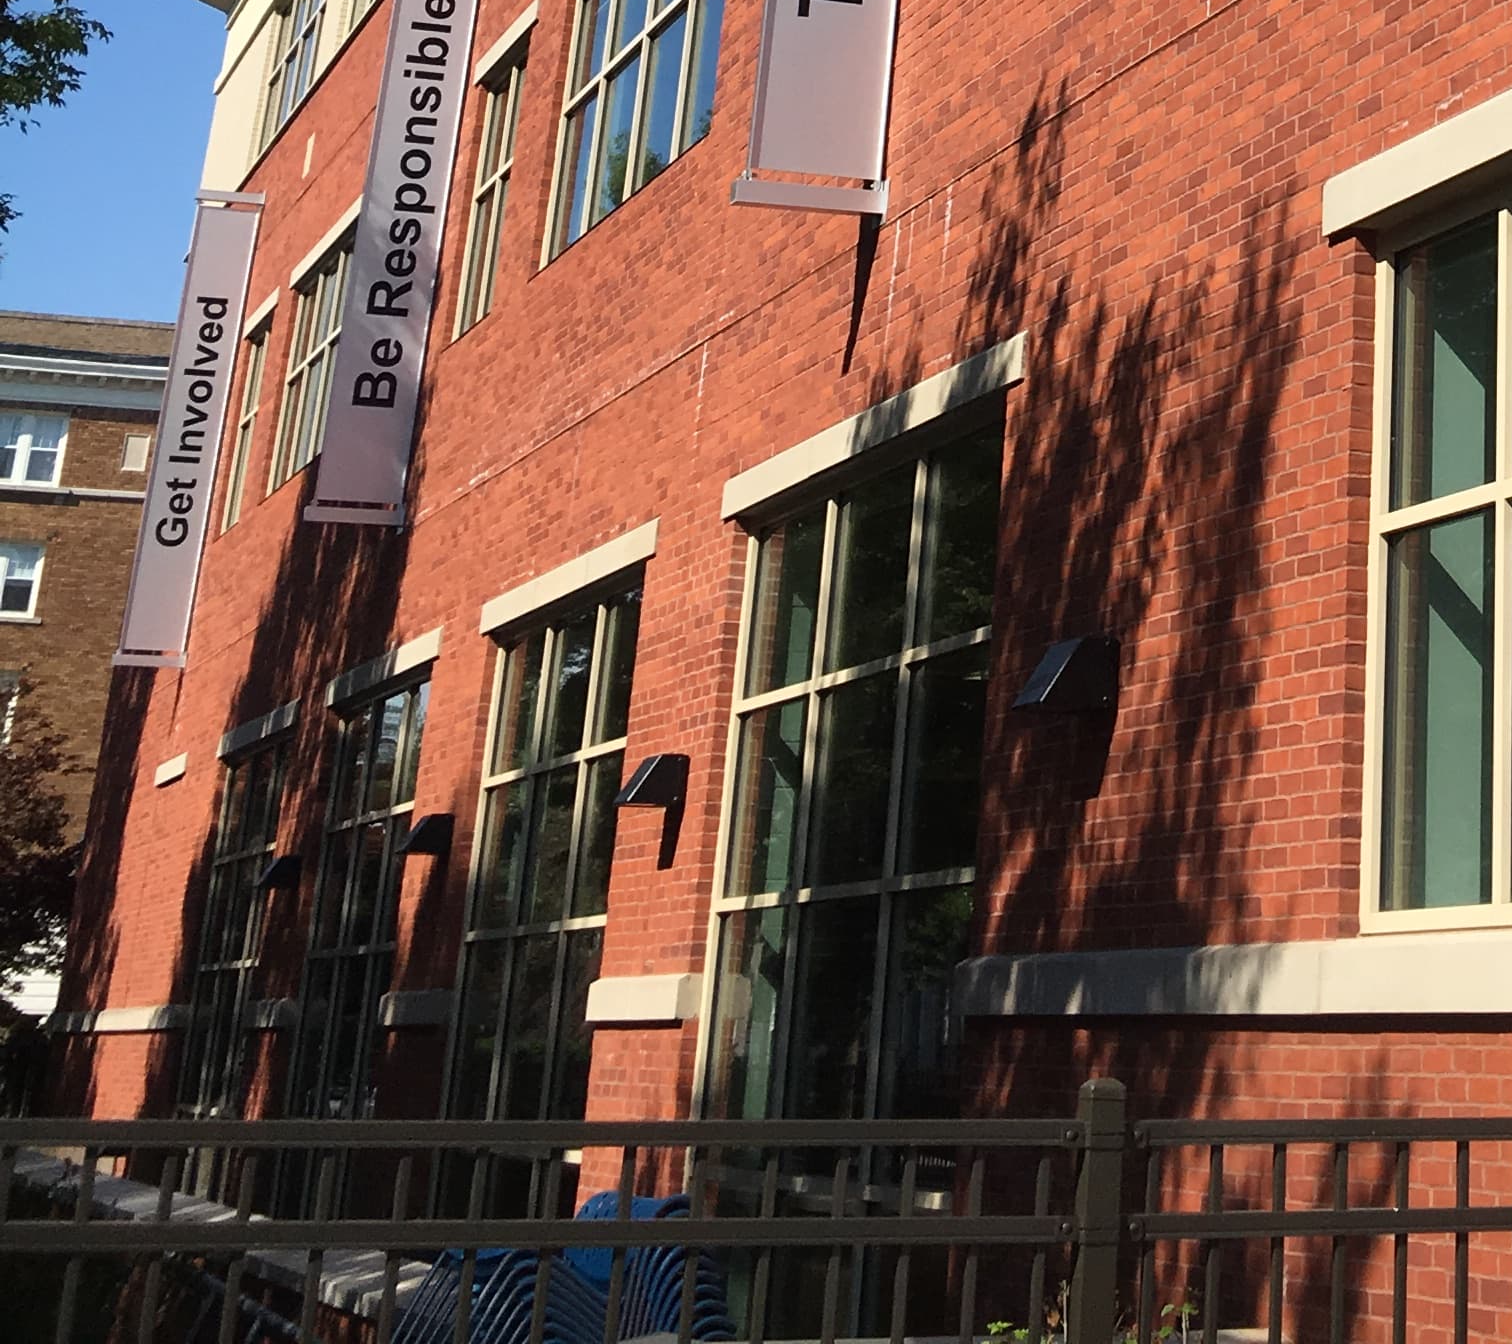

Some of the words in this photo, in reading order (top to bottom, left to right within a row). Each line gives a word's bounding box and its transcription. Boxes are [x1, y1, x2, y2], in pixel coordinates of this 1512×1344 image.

[168, 295, 230, 466] Involved
[351, 337, 405, 410] Be
[154, 476, 199, 548] Get
